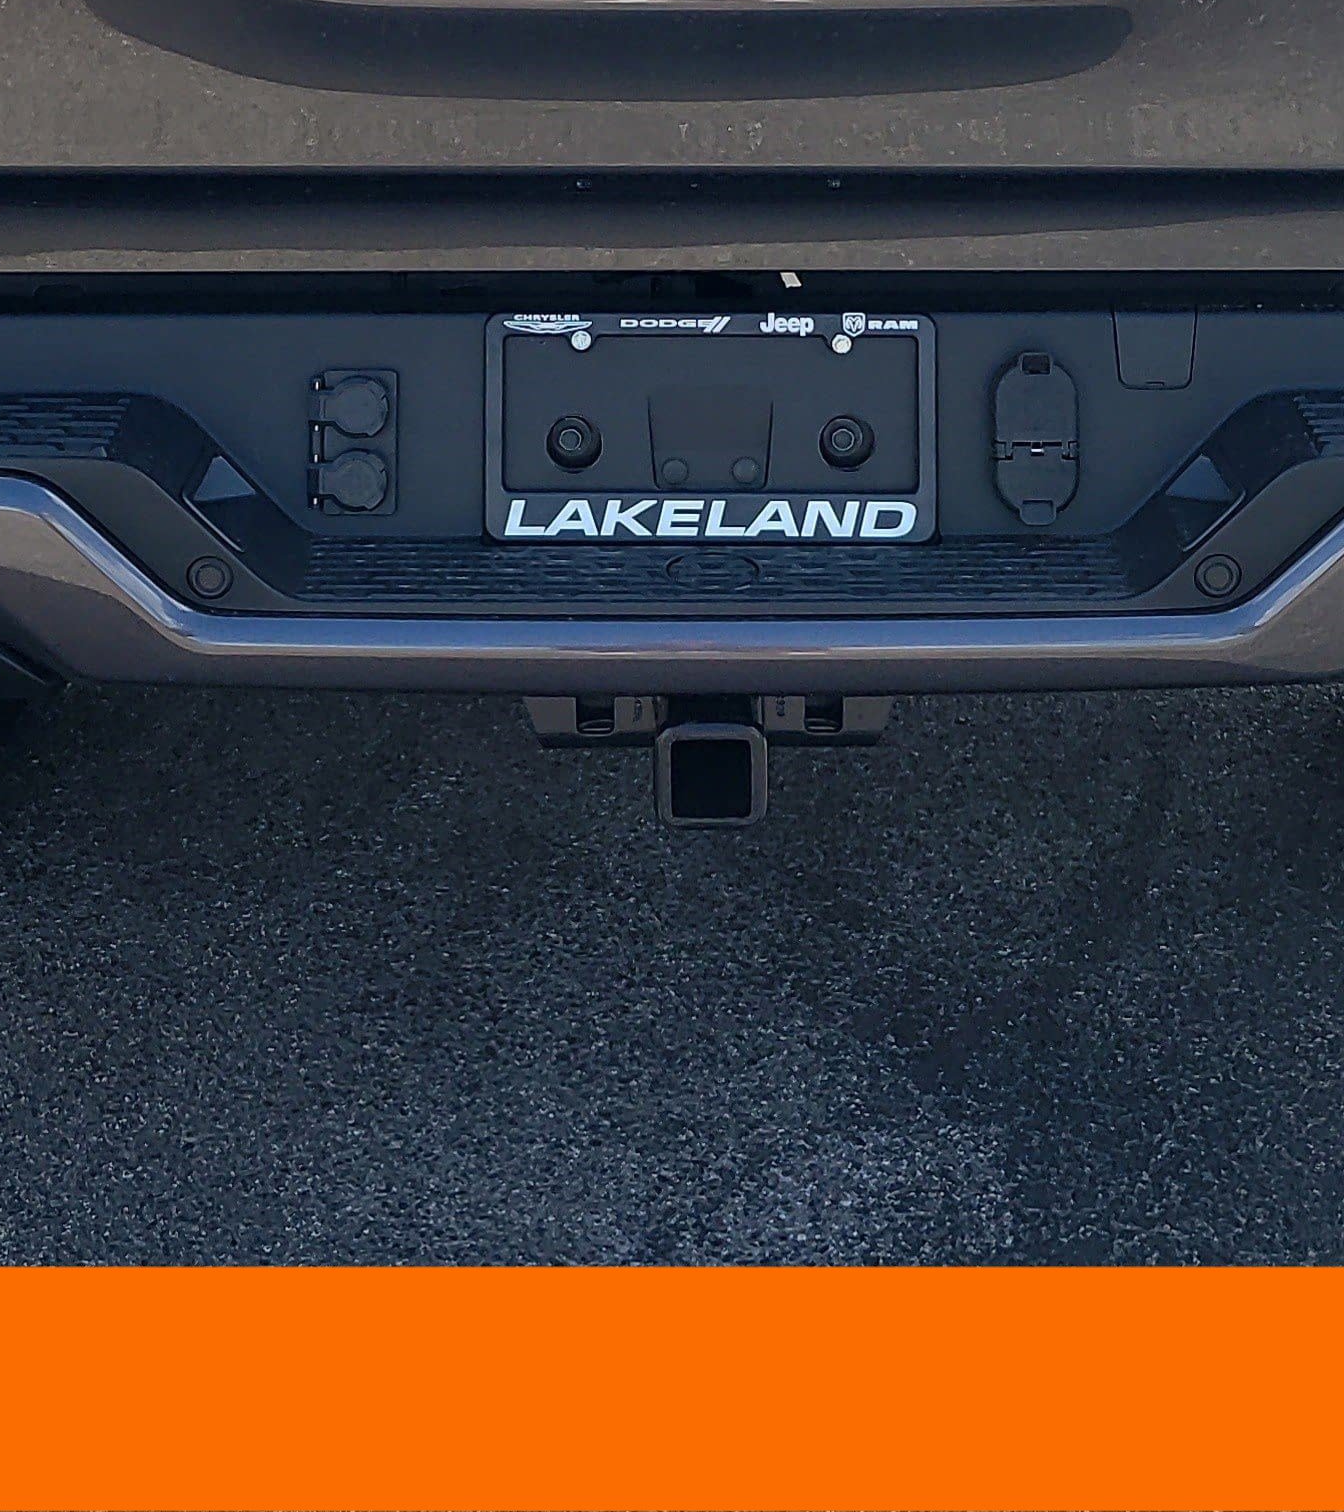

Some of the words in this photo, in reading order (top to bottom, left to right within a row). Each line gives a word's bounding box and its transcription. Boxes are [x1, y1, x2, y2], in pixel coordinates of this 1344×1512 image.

[619, 318, 715, 329] DODGE
[759, 312, 814, 337] Jeep
[868, 320, 918, 330] RAM
[504, 500, 917, 537] LAKELAND
